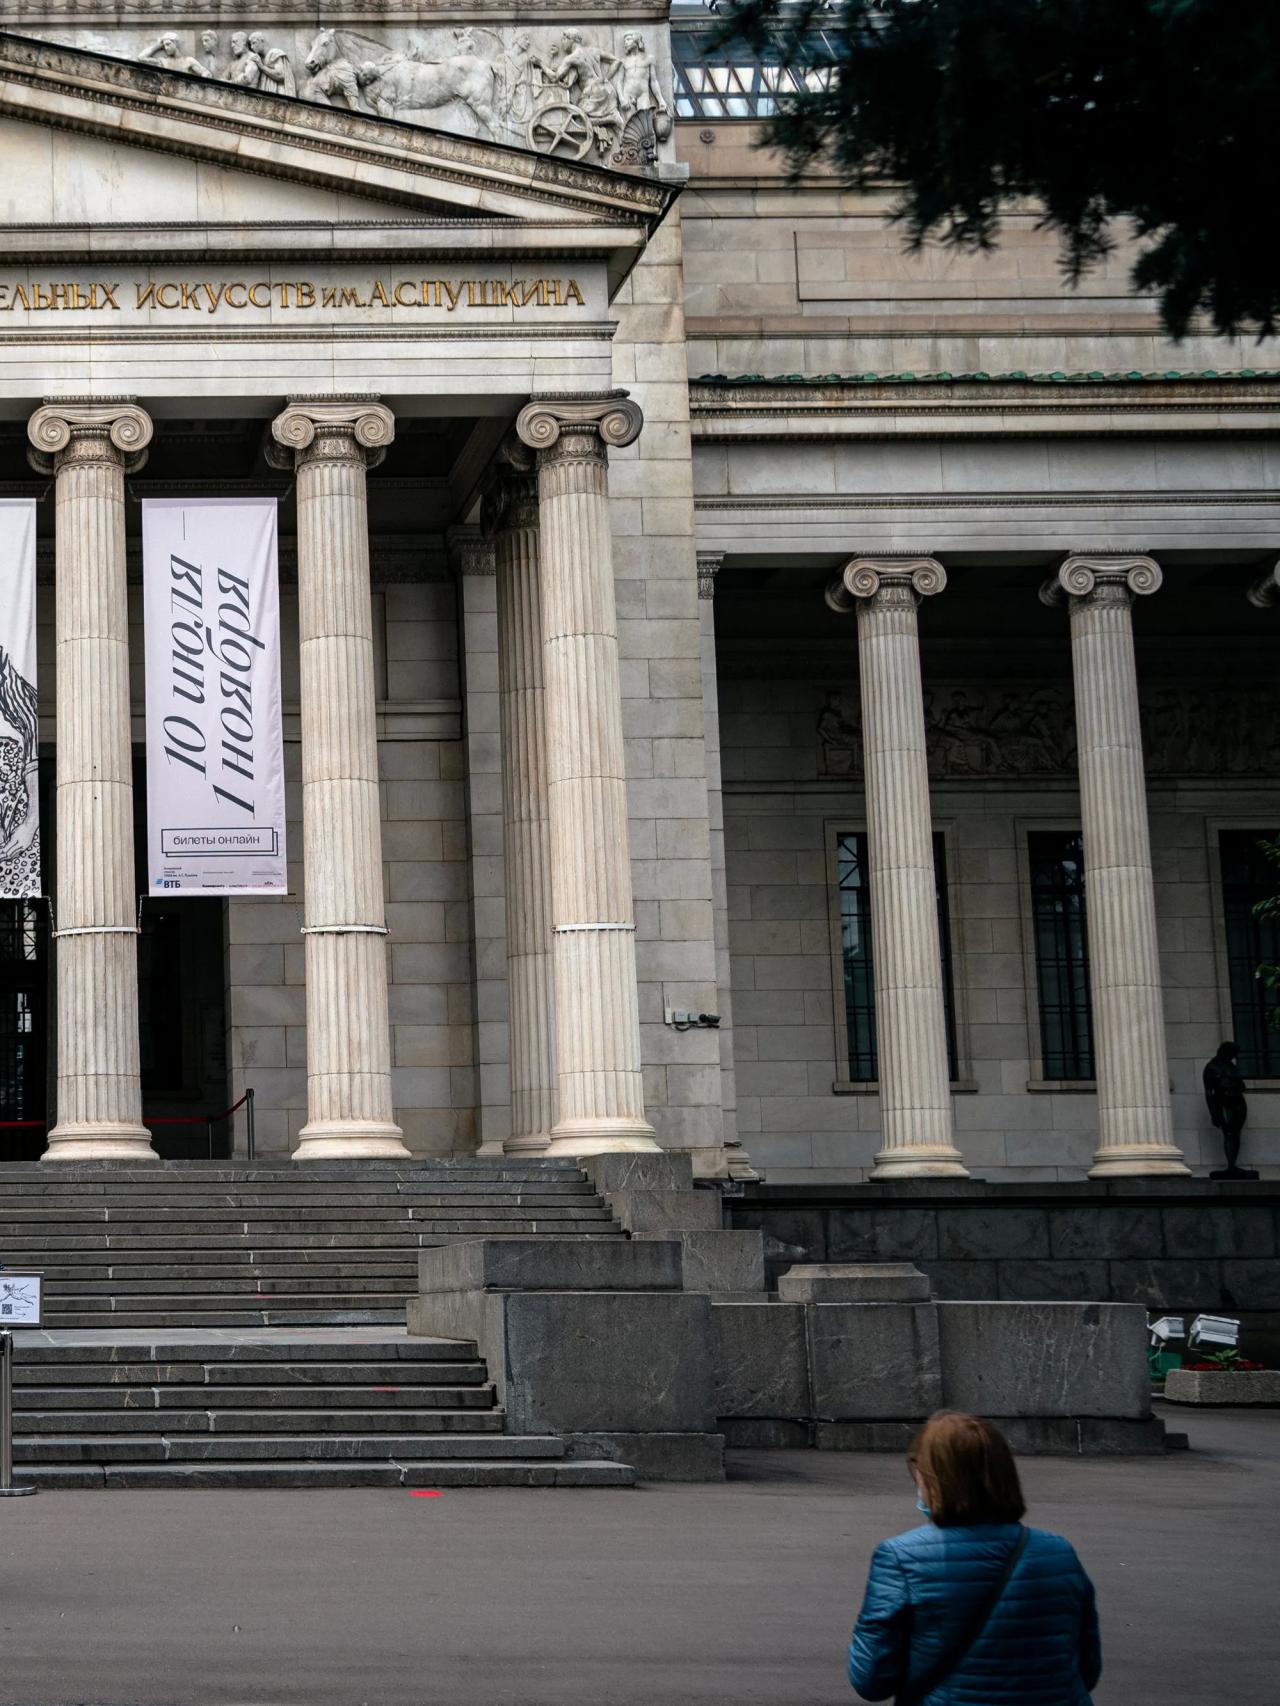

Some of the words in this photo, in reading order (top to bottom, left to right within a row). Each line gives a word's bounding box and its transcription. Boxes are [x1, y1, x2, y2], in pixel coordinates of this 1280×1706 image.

[133, 280, 317, 313] ИСКУССТВ
[169, 553, 206, 705] июля
[205, 566, 267, 782] ноября
[163, 714, 208, 781] 10
[212, 782, 256, 820] 1
[173, 836, 216, 845] билеты
[217, 834, 260, 845] онлайн
[163, 880, 181, 889] ВТБ
